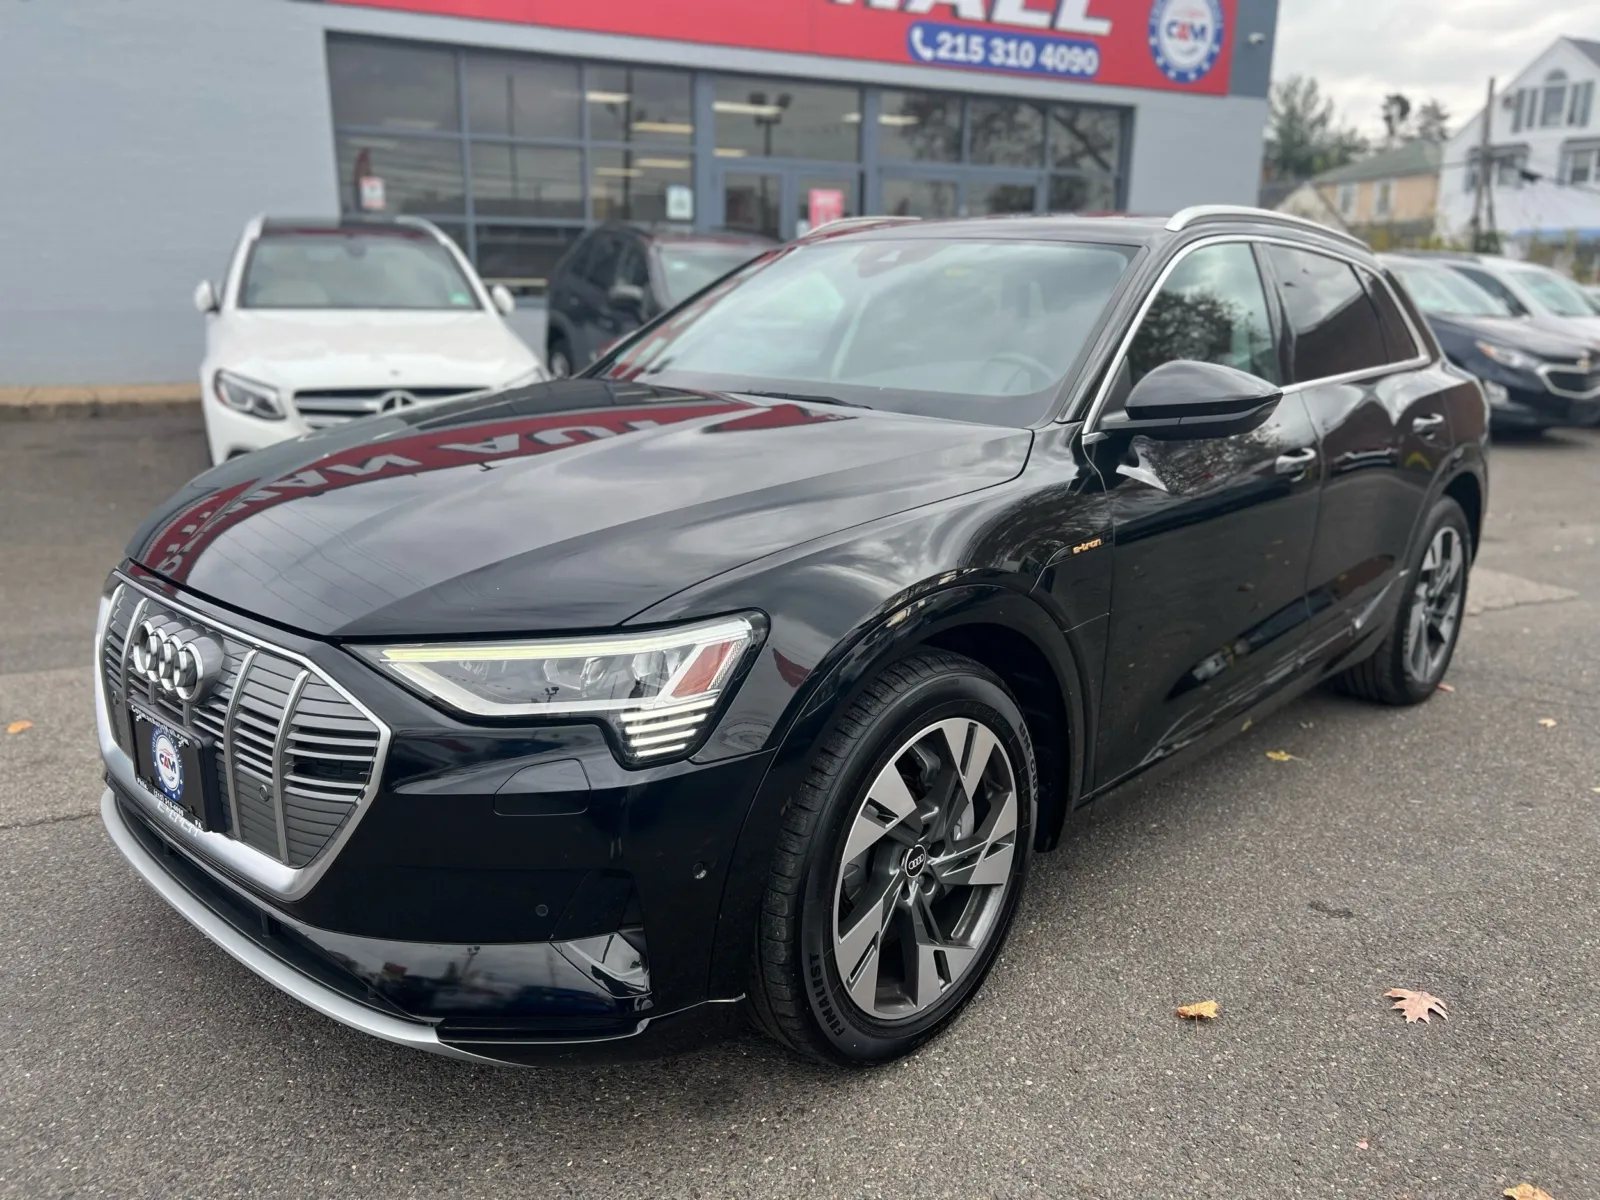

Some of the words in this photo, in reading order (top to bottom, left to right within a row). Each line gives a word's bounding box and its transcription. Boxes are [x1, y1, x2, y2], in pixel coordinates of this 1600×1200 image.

[937, 33, 984, 64] 215
[988, 36, 1035, 68] 310
[1039, 42, 1099, 75] 4090
[1072, 537, 1102, 554] e-tron
[809, 952, 846, 1037] FINALIST
